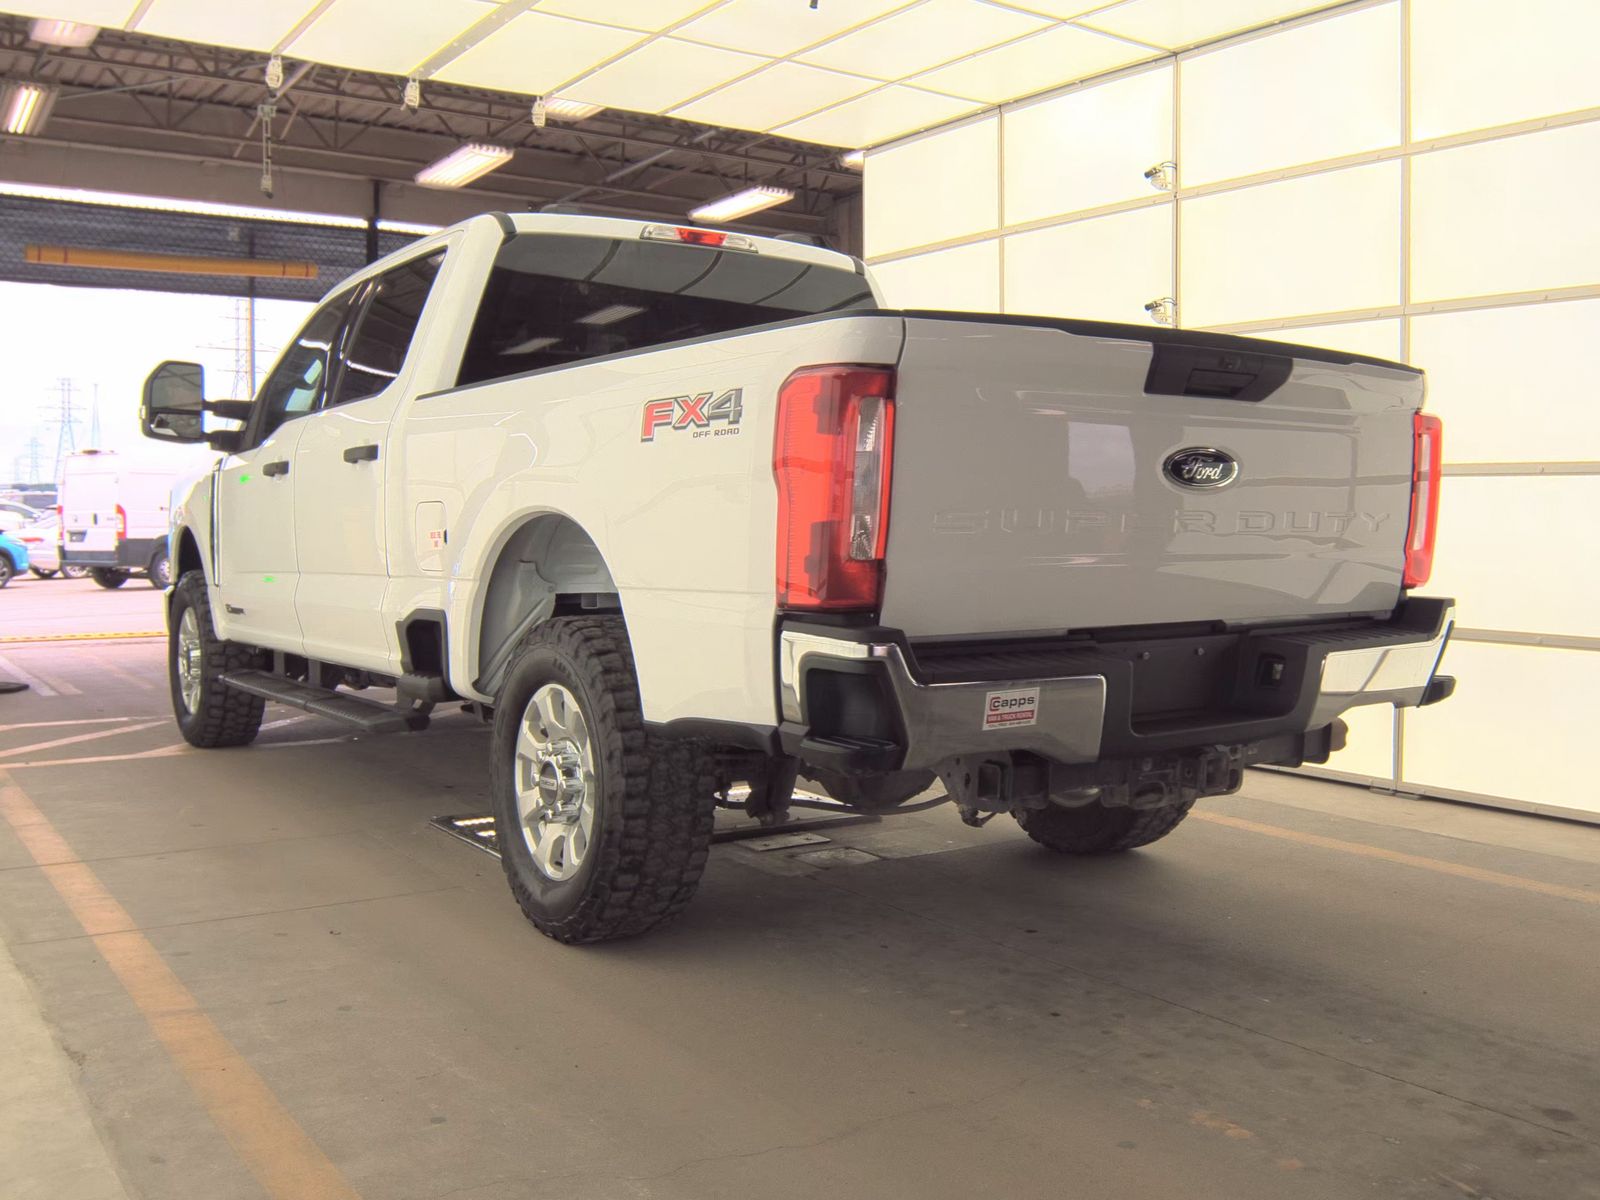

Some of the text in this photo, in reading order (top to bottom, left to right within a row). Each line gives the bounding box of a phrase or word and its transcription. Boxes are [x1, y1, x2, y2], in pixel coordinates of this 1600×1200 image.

[641, 387, 743, 442] FX4
[692, 427, 740, 439] OFF ROAD
[1177, 455, 1222, 480] Ford
[1237, 510, 1391, 534] DUTY
